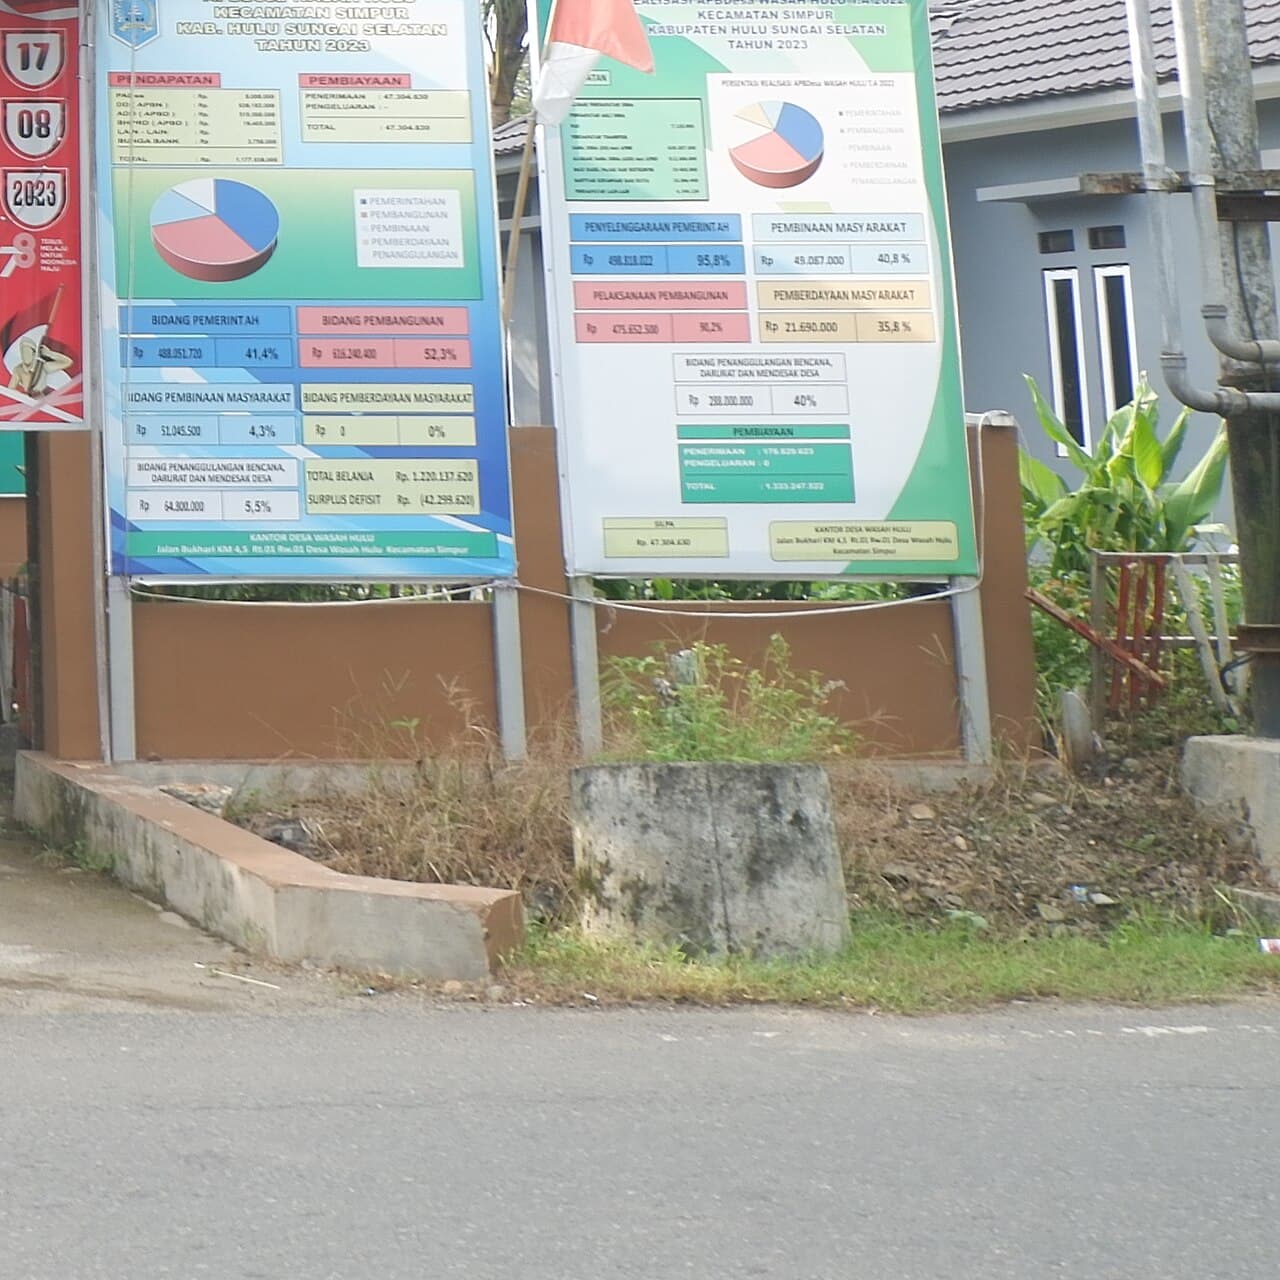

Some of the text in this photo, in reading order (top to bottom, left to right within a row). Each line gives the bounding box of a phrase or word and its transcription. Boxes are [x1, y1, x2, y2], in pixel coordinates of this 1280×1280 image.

[214, 6, 408, 19] KECAMATAN SIMPUR
[698, 10, 833, 20] KECAMATAN SIMPUR
[177, 23, 447, 36] KAB. HULU SUNGAI SELATAN
[648, 25, 885, 34] KABUPATEN HULU SUNGAI SELATAN
[256, 39, 370, 52] TAHUN 2023
[728, 39, 808, 50] TAHUN 2023
[16, 42, 50, 71] 17
[309, 76, 402, 85] PEMBIAYAAN
[17, 109, 51, 139] 08
[12, 180, 57, 207] 2023
[151, 315, 190, 326] BIDANG
[321, 315, 360, 326] BIDANG
